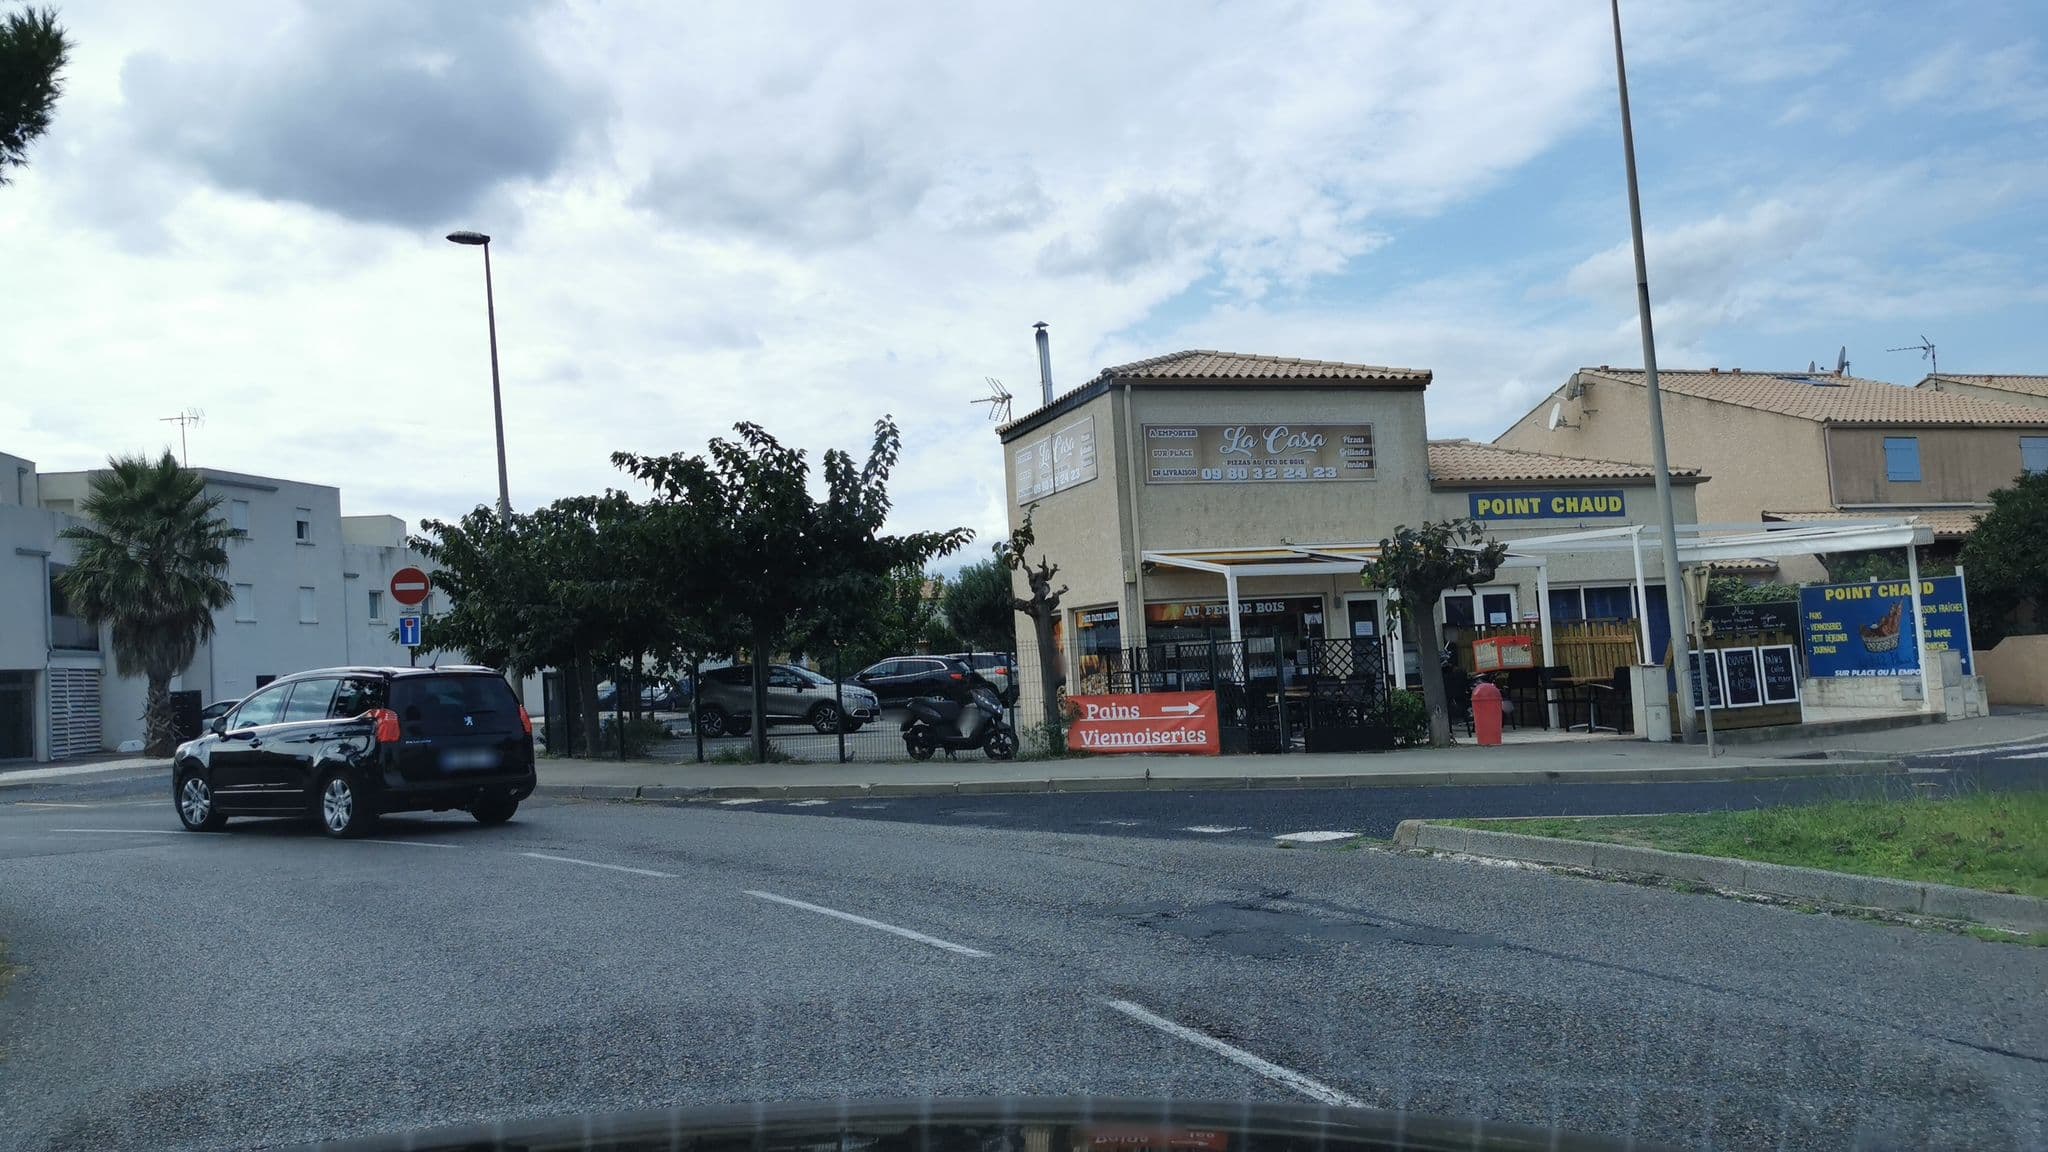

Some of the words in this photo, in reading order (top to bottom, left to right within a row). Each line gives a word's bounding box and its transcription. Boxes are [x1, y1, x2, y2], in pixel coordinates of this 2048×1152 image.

[1157, 429, 1197, 438] EMPORTER
[1219, 426, 1259, 457] La
[1263, 426, 1328, 455] Casa
[1152, 449, 1168, 458] SUR
[1168, 449, 1194, 458] PLACE
[1339, 447, 1370, 457] Grillades
[1151, 469, 1162, 477] EN
[1162, 468, 1198, 477] LIVRAISON
[1201, 467, 1222, 481] 09
[1253, 467, 1278, 480] 32
[1477, 498, 1541, 516] POINT
[1551, 496, 1622, 514] CHAUD
[1825, 587, 1872, 600] POINT
[1184, 605, 1201, 616] AU
[1256, 602, 1286, 613] BOIS
[1834, 669, 1850, 677] SUR
[1851, 669, 1876, 677] PLACE
[1086, 702, 1141, 720] Pains
[1080, 726, 1207, 746] Viennoiseries
